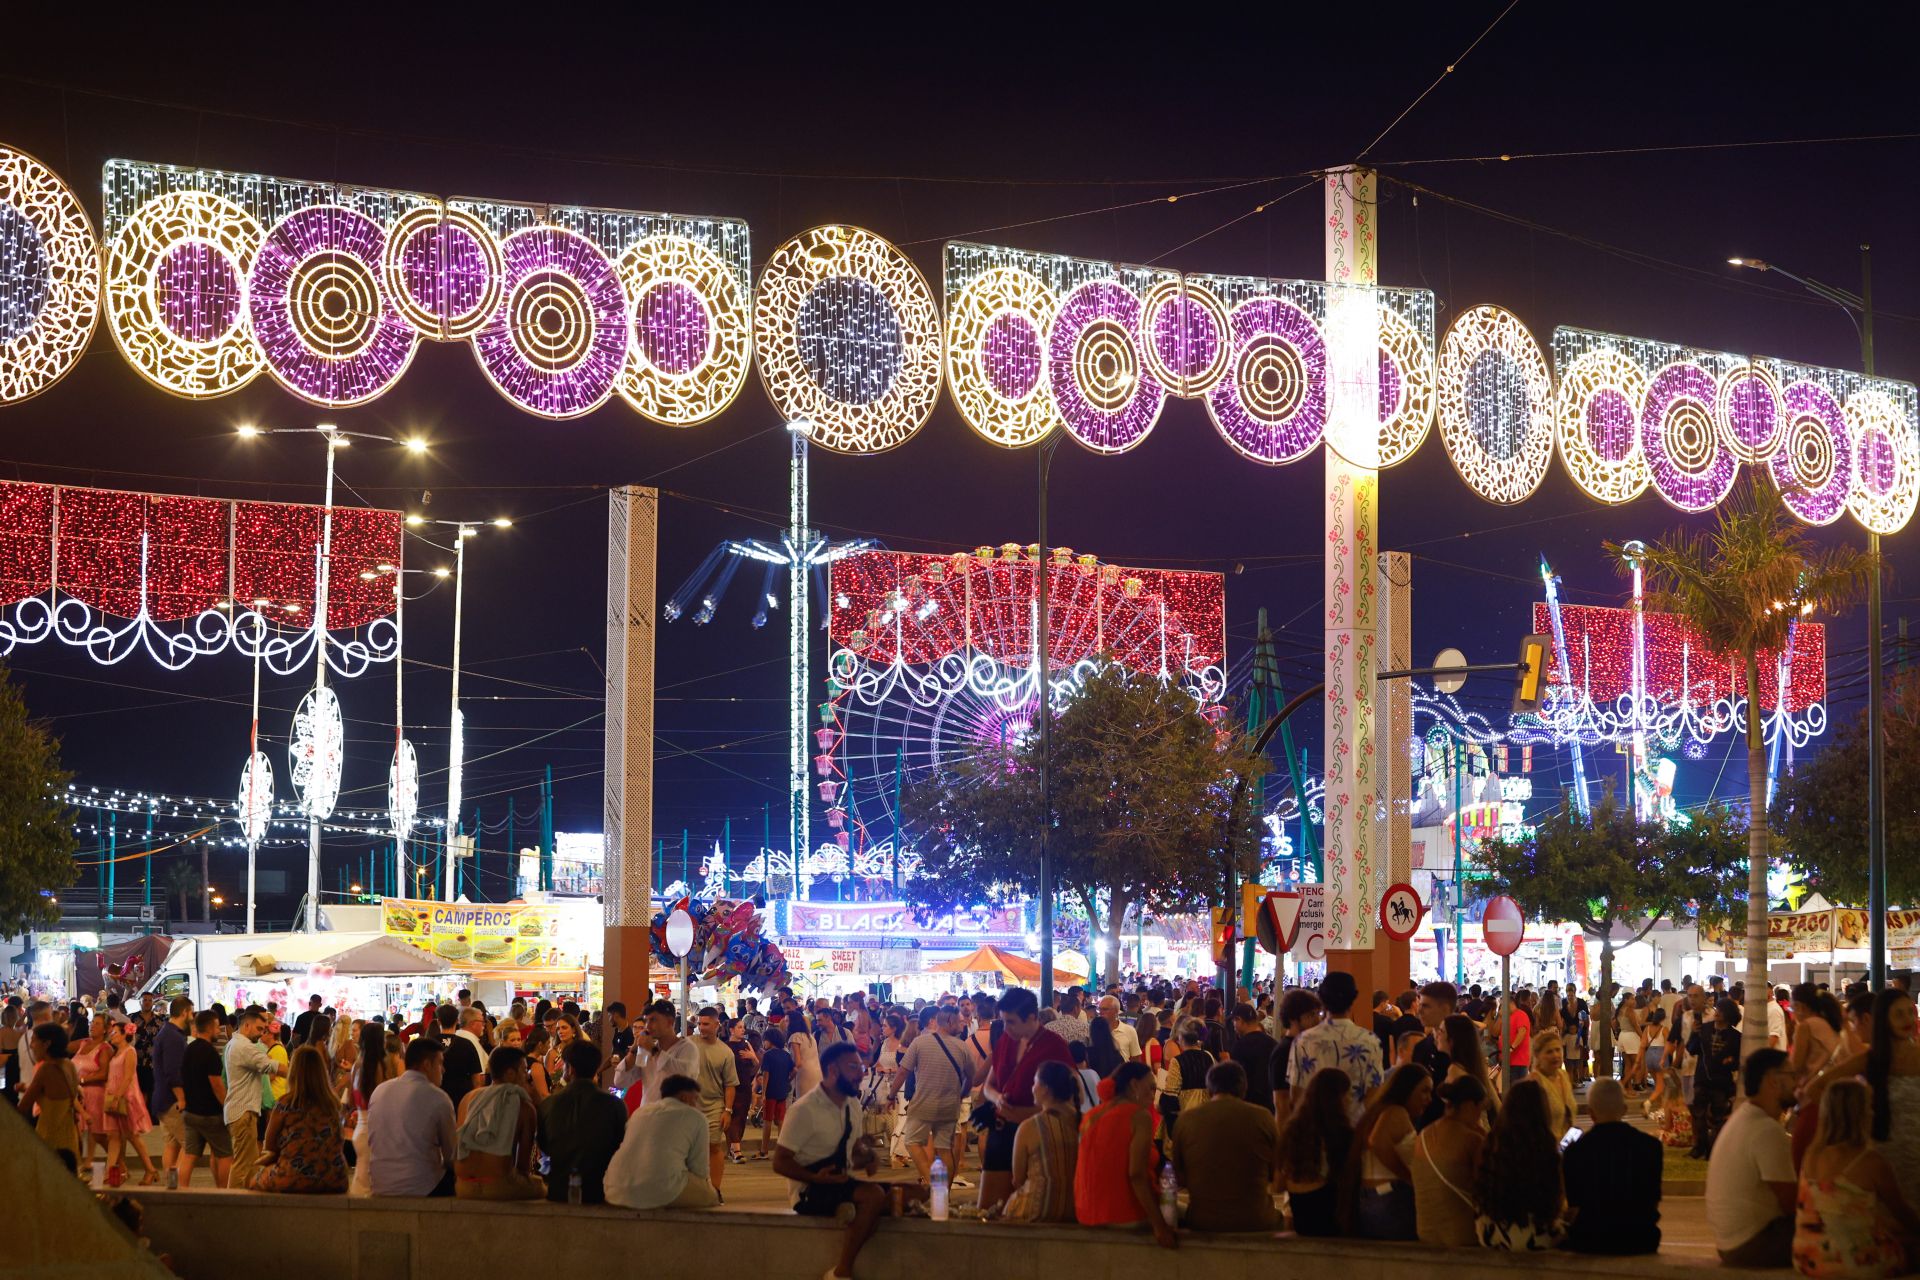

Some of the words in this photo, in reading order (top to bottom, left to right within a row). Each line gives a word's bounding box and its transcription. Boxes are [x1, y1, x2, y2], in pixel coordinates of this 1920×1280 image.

[434, 909, 512, 927] CAMPEROS
[819, 913, 905, 931] BLACK
[917, 912, 991, 931] JACK
[1787, 914, 1830, 933] PACO
[831, 950, 857, 961] SWEET
[833, 961, 854, 973] CORN
